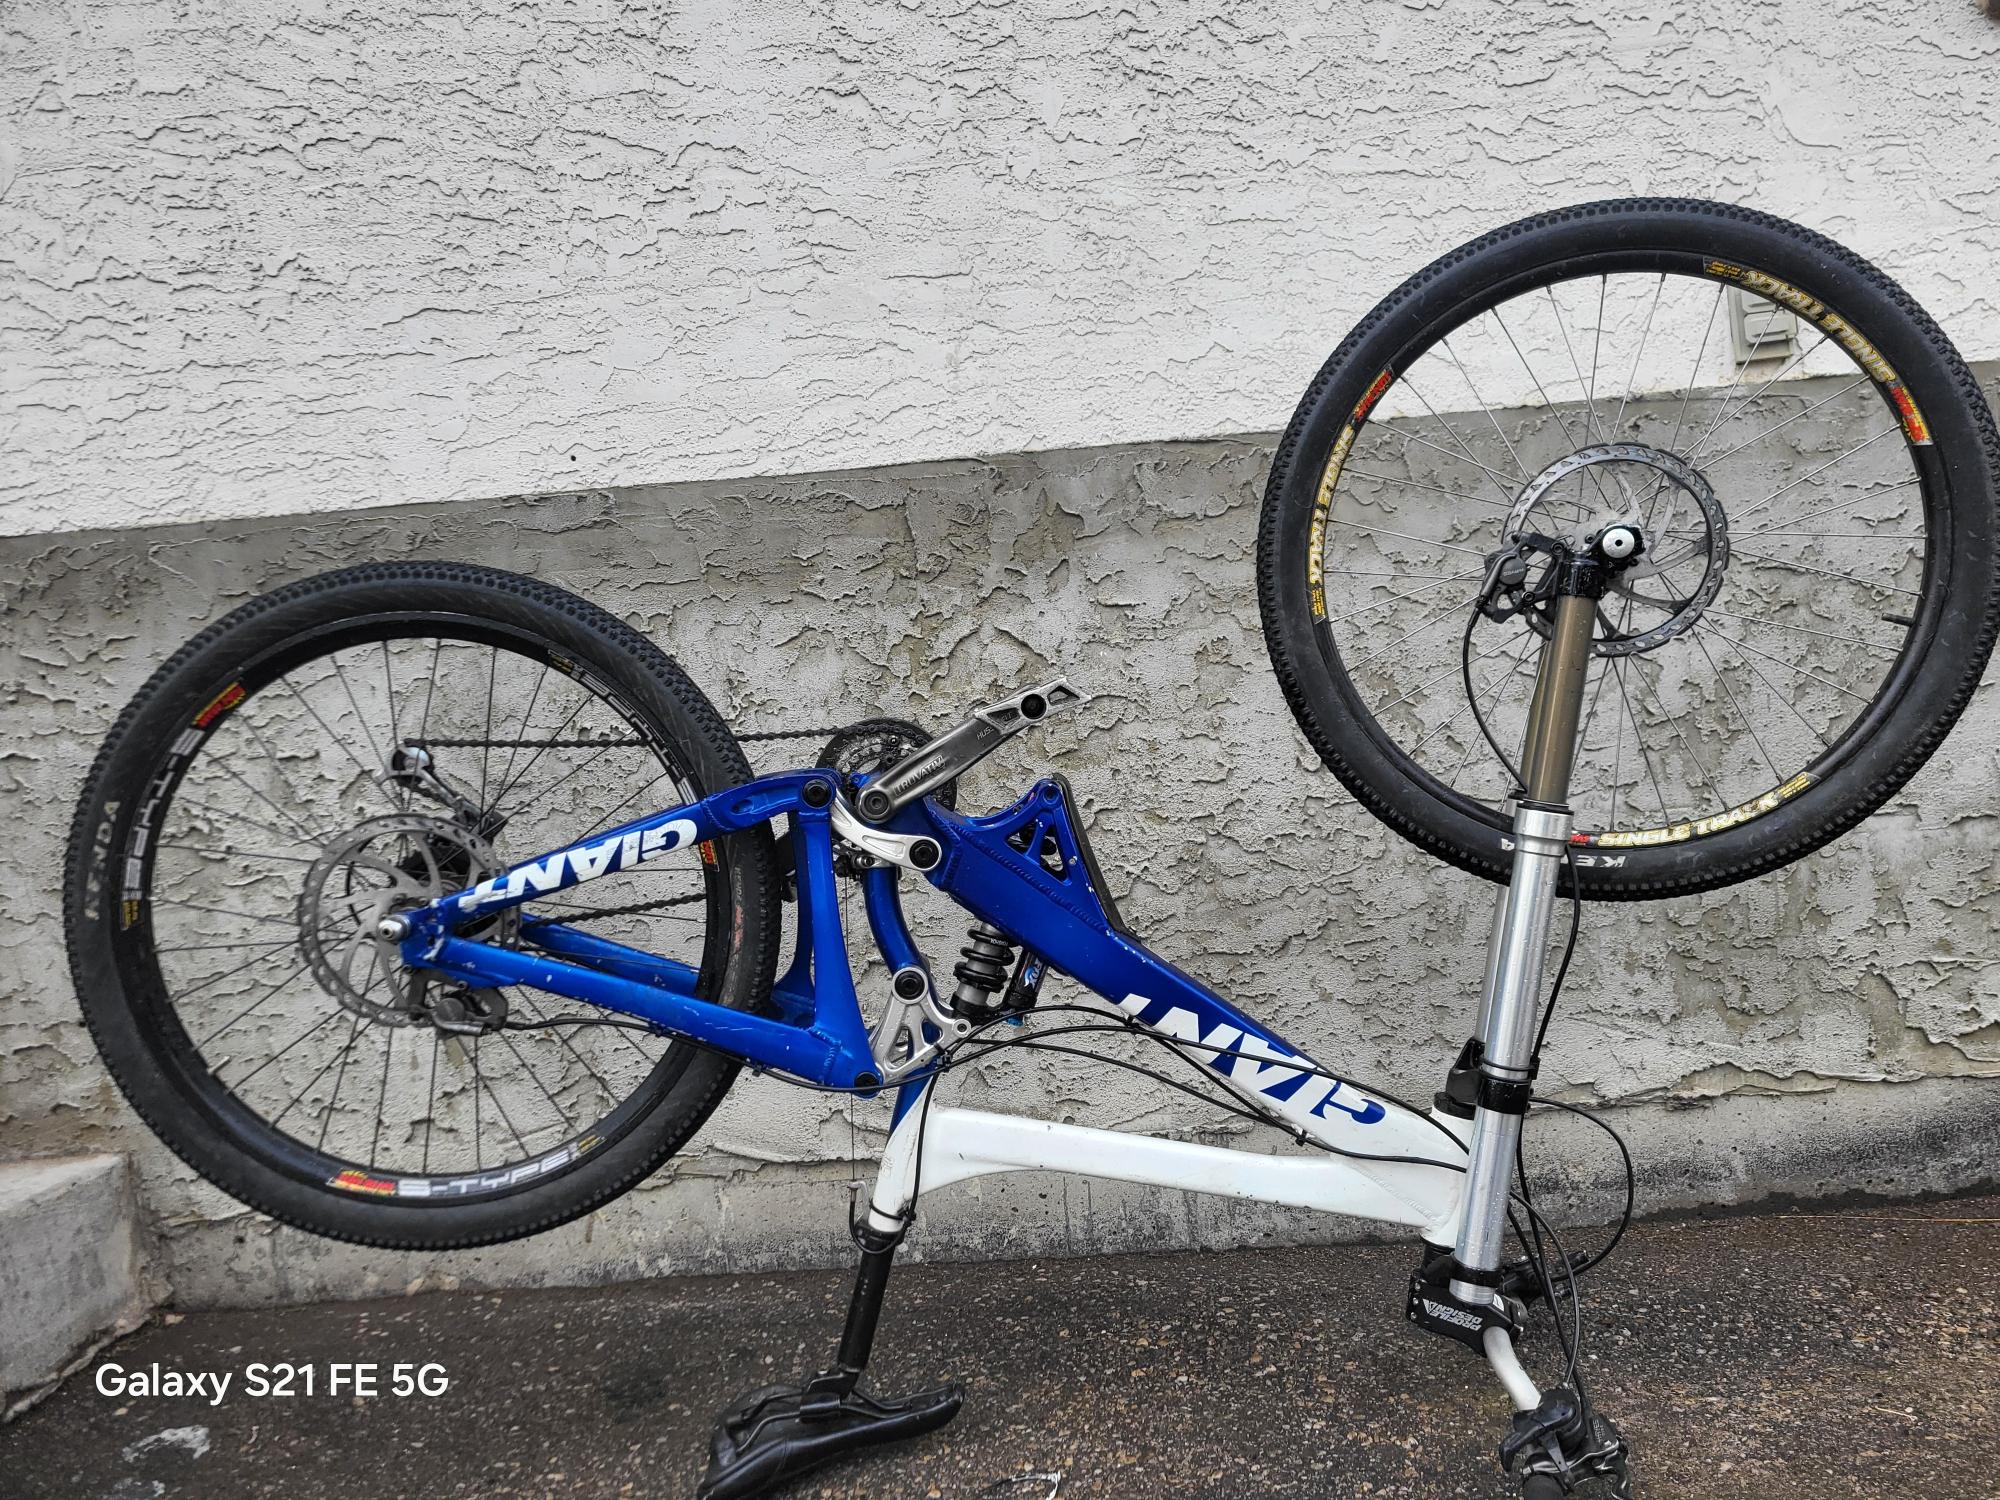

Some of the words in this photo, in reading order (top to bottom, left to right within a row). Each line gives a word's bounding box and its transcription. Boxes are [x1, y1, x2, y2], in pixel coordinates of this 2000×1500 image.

[1741, 269, 1826, 322] TRACK
[1819, 312, 1896, 384] SINGLE
[1317, 423, 1355, 506] SINGLE
[1309, 507, 1328, 584] TRACK
[1597, 821, 1691, 847] SINGLE
[1694, 790, 1780, 836] TRACK
[457, 818, 698, 911] GIANT
[397, 1150, 571, 1198] S-TYPE
[1431, 1309, 1481, 1331] PROFILE
[1435, 1304, 1482, 1324] DESIGN
